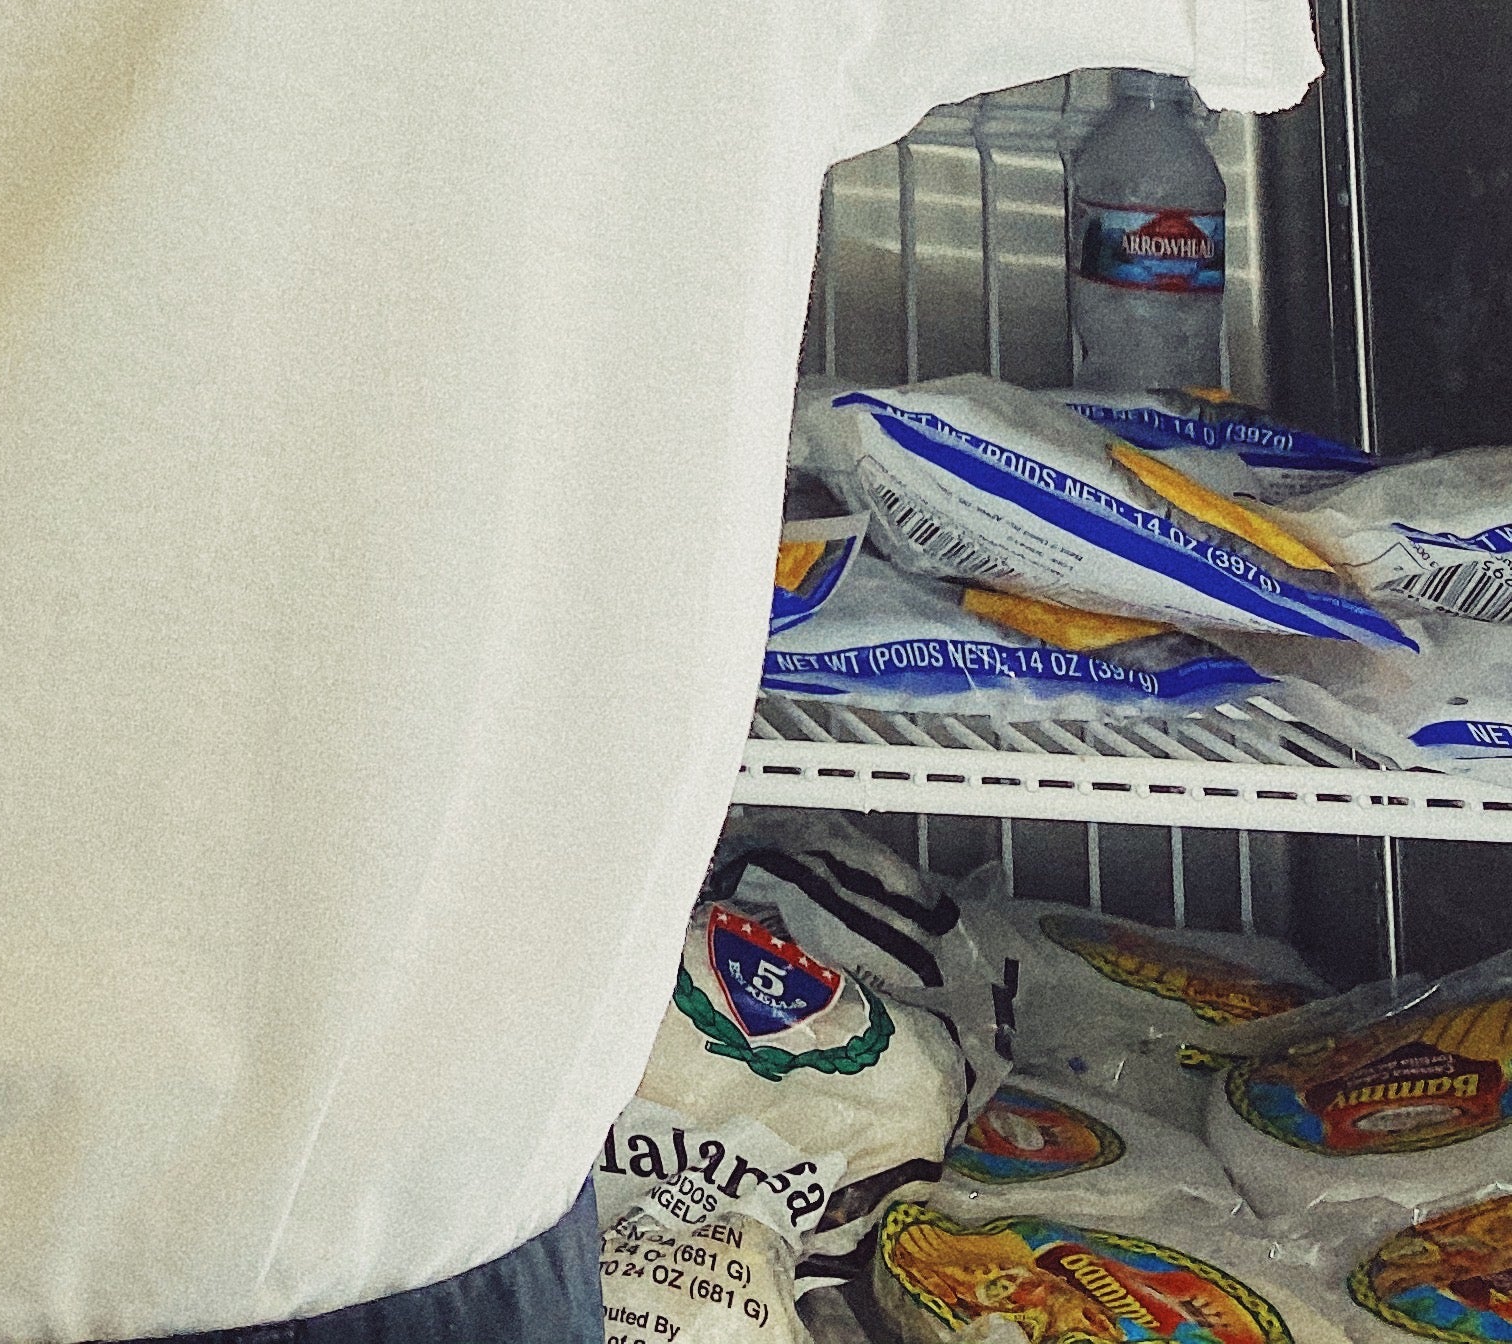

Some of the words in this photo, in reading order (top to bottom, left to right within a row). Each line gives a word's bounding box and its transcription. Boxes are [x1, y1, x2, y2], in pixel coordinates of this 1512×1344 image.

[1121, 234, 1215, 260] ARROWHEAD
[1134, 512, 1161, 536] 14
[777, 652, 819, 672] NET
[824, 652, 862, 674] WT
[868, 641, 944, 678] (POIDS
[1015, 649, 1044, 674] 14
[1051, 652, 1083, 677] OZ
[752, 959, 788, 997] 5
[673, 1244, 717, 1272] (681
[622, 1263, 645, 1278] 24
[652, 1265, 685, 1290] OZ
[689, 1276, 736, 1309] (681
[743, 1298, 770, 1329] G)
[654, 1315, 681, 1343] By
